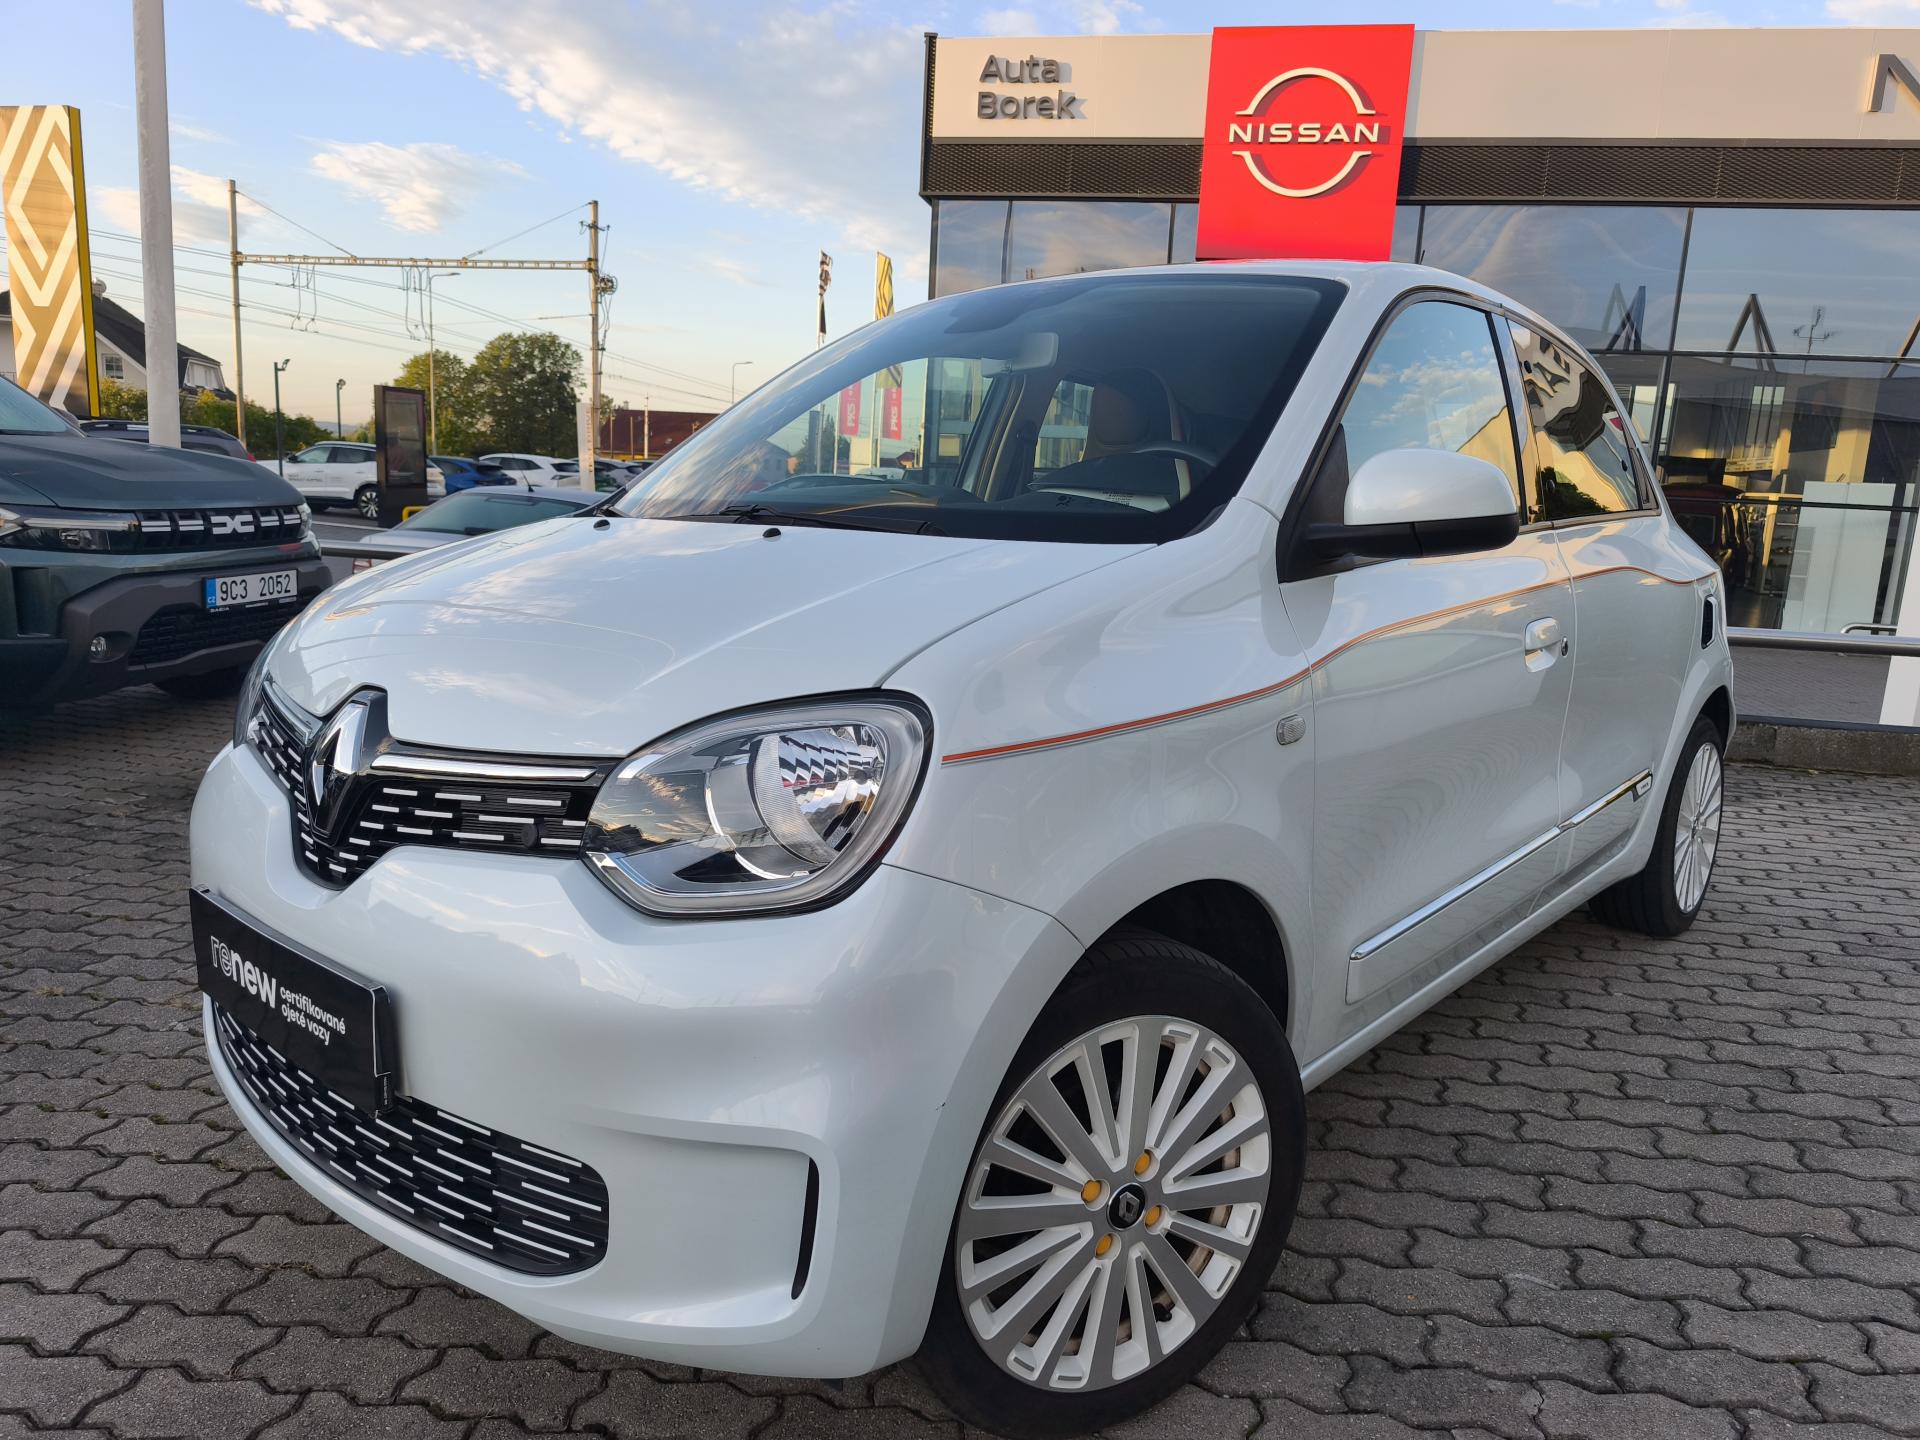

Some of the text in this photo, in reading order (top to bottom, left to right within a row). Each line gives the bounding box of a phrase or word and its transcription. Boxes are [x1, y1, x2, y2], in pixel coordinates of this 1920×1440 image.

[979, 54, 1060, 83] Auta
[977, 89, 1077, 119] Borek
[1228, 122, 1380, 144] NISSAN
[220, 573, 292, 602] 9C3 2052
[210, 935, 277, 1009] renew
[280, 986, 346, 1035] certifikované
[281, 1003, 331, 1046] ojeté vozy
